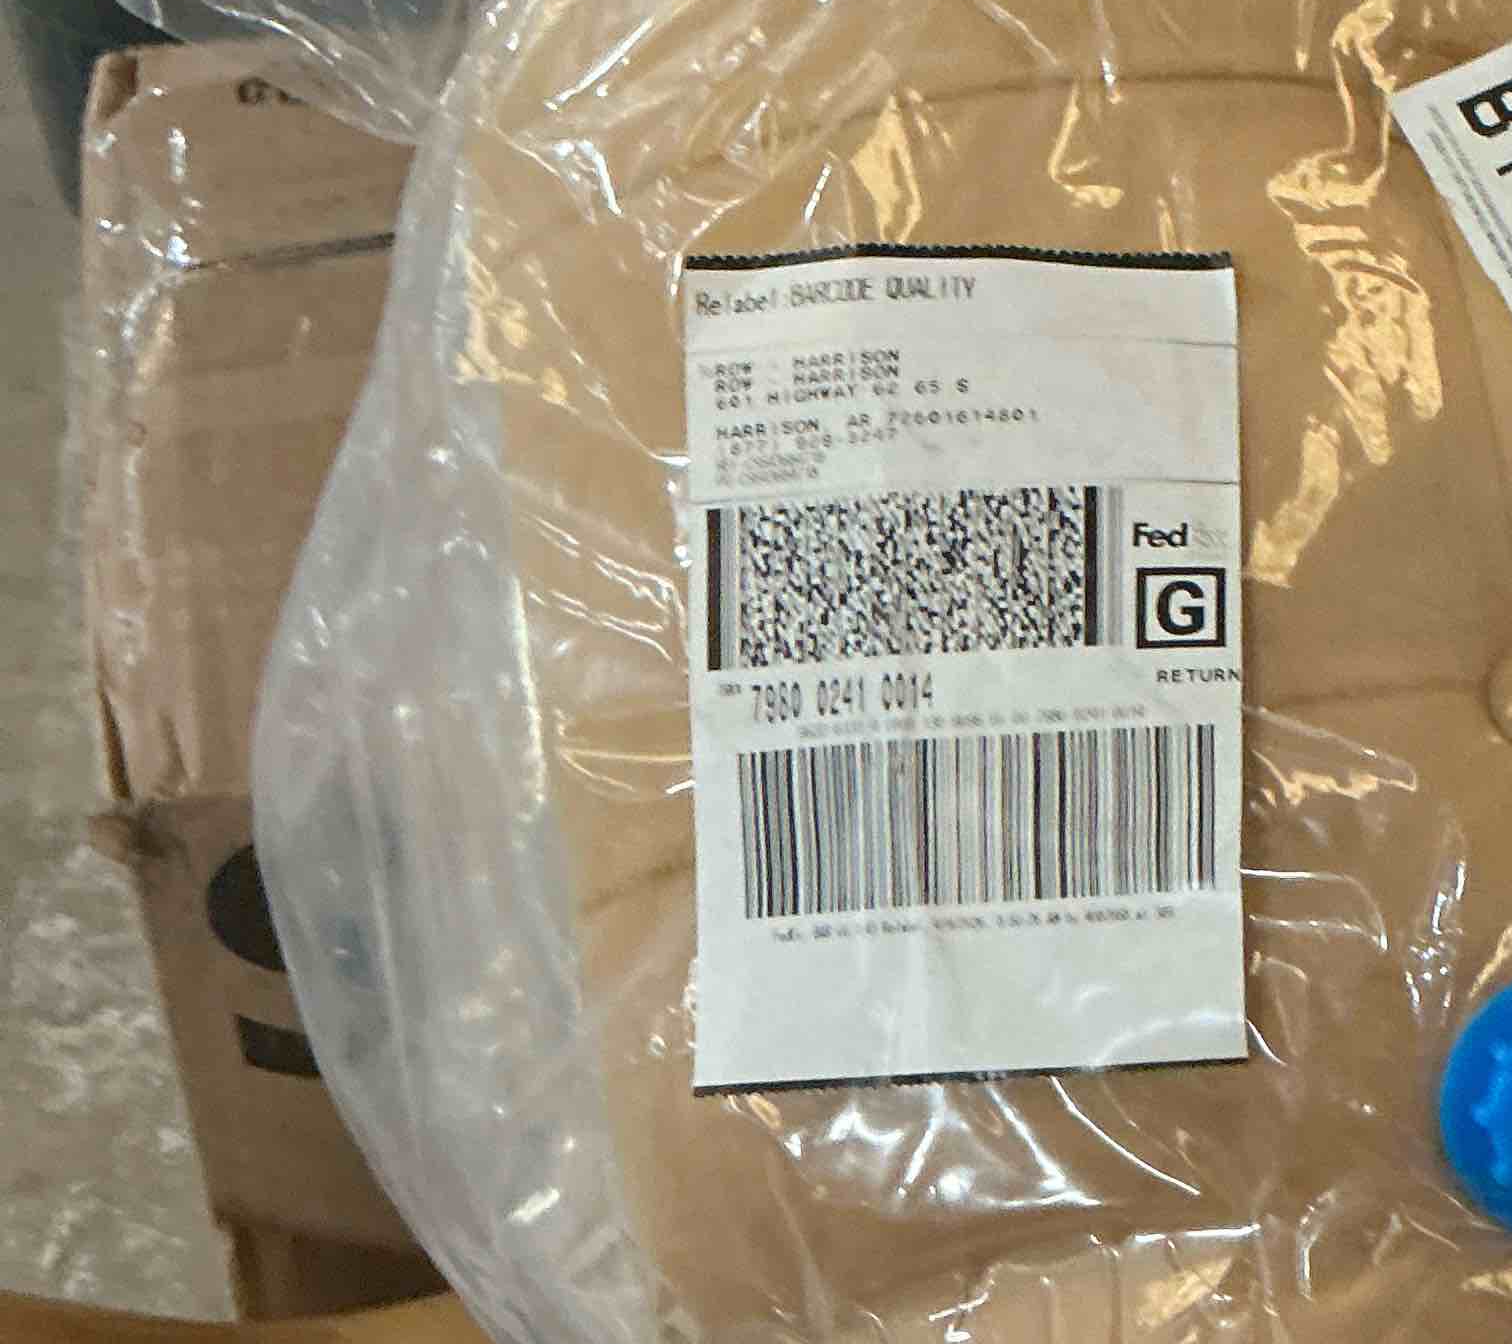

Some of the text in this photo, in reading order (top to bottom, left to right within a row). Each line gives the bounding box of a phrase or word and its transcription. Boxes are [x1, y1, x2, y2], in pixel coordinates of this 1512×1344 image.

[885, 274, 977, 301] QUALITY
[1157, 580, 1205, 635] G
[1156, 668, 1240, 683] RETURN
